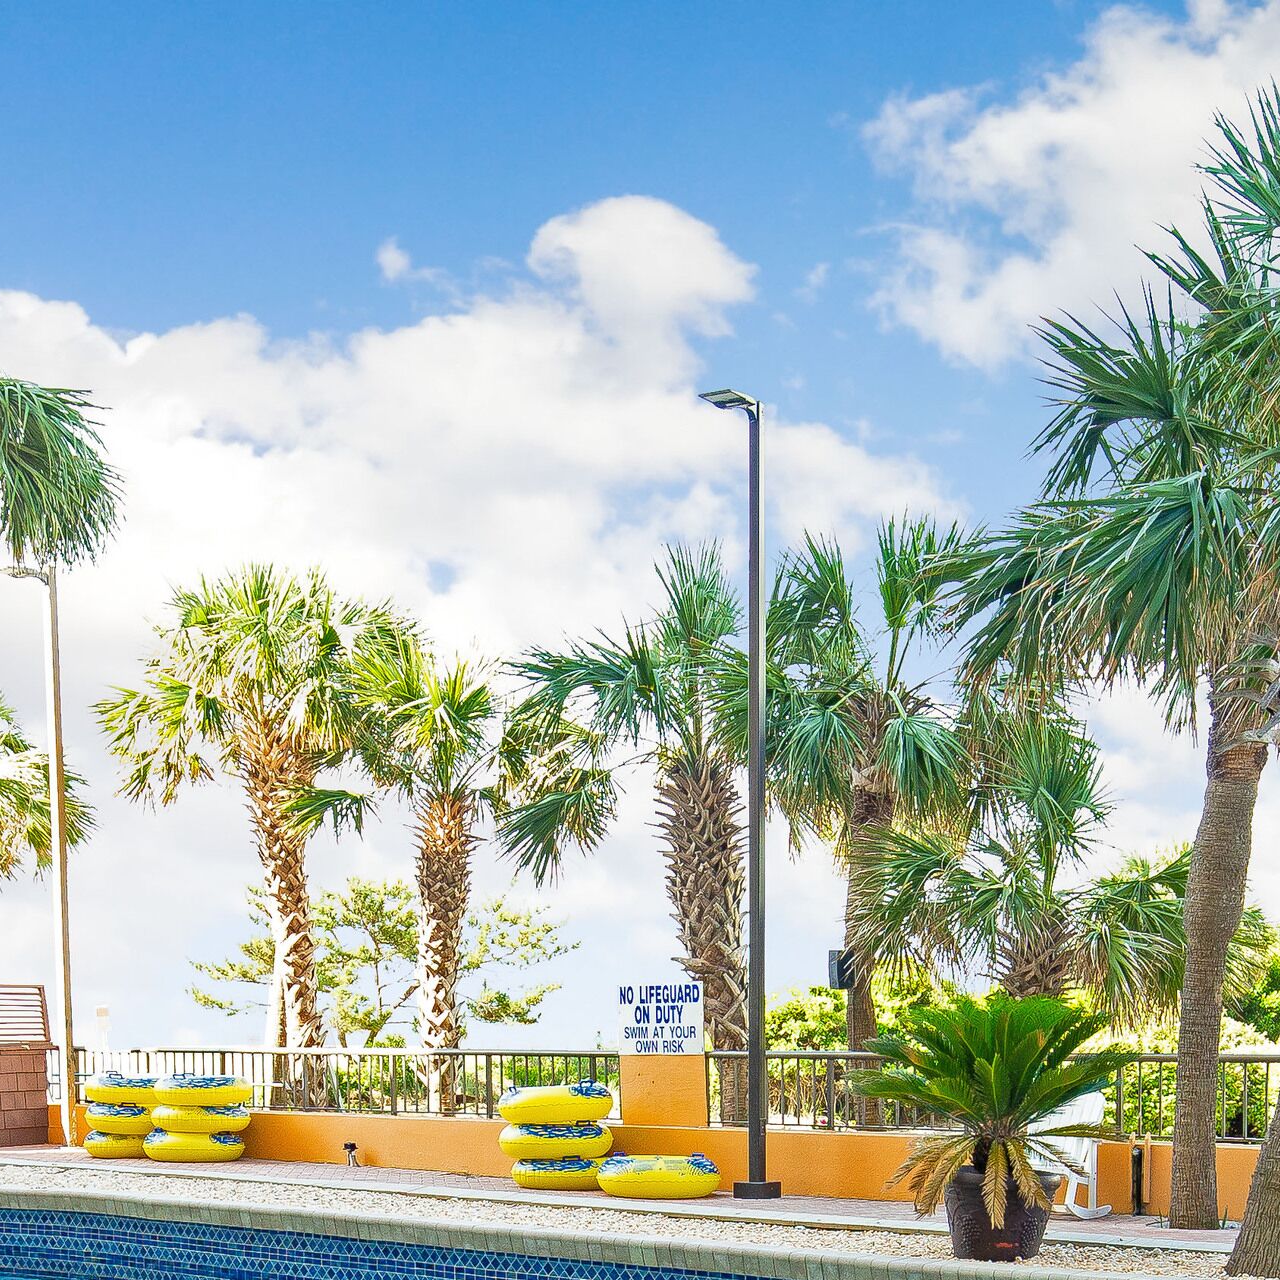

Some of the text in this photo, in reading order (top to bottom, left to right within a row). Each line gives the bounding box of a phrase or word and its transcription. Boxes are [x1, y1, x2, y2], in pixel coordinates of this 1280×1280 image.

[620, 984, 700, 1004] NO LIFEGUARD
[635, 1005, 683, 1024] ON DUTY
[624, 1026, 696, 1039] SWIM AT YOUR
[635, 1040, 684, 1053] OWN RISK
